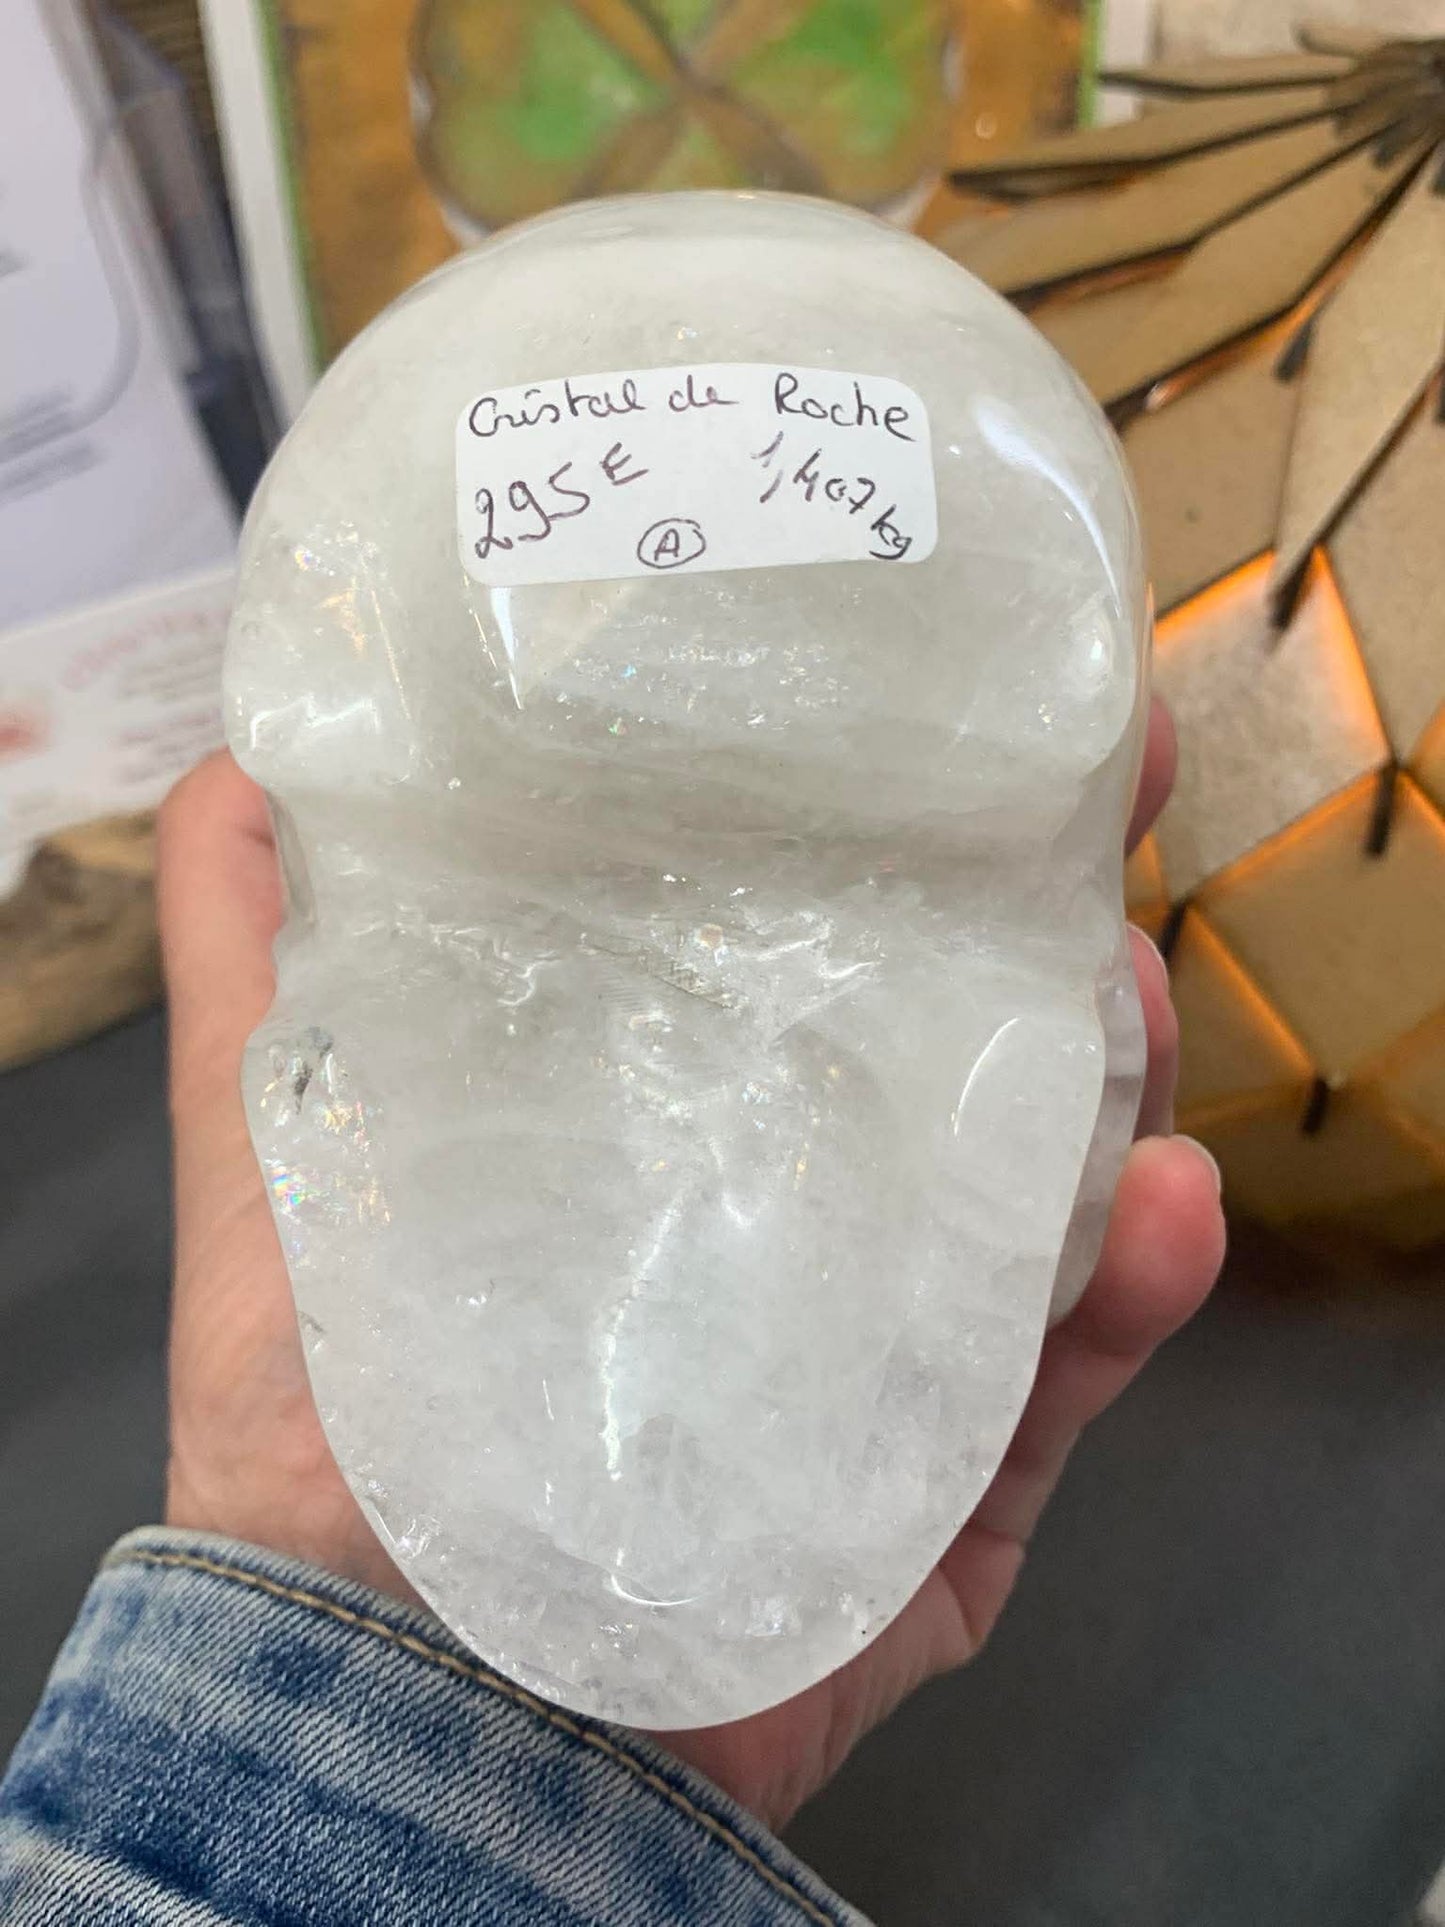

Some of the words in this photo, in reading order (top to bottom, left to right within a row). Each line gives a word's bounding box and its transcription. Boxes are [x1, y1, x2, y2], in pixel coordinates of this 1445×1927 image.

[469, 378, 645, 438] Cristal
[668, 375, 740, 413] de
[774, 372, 916, 442] Roche
[474, 461, 591, 559] 295
[869, 504, 914, 561] kg
